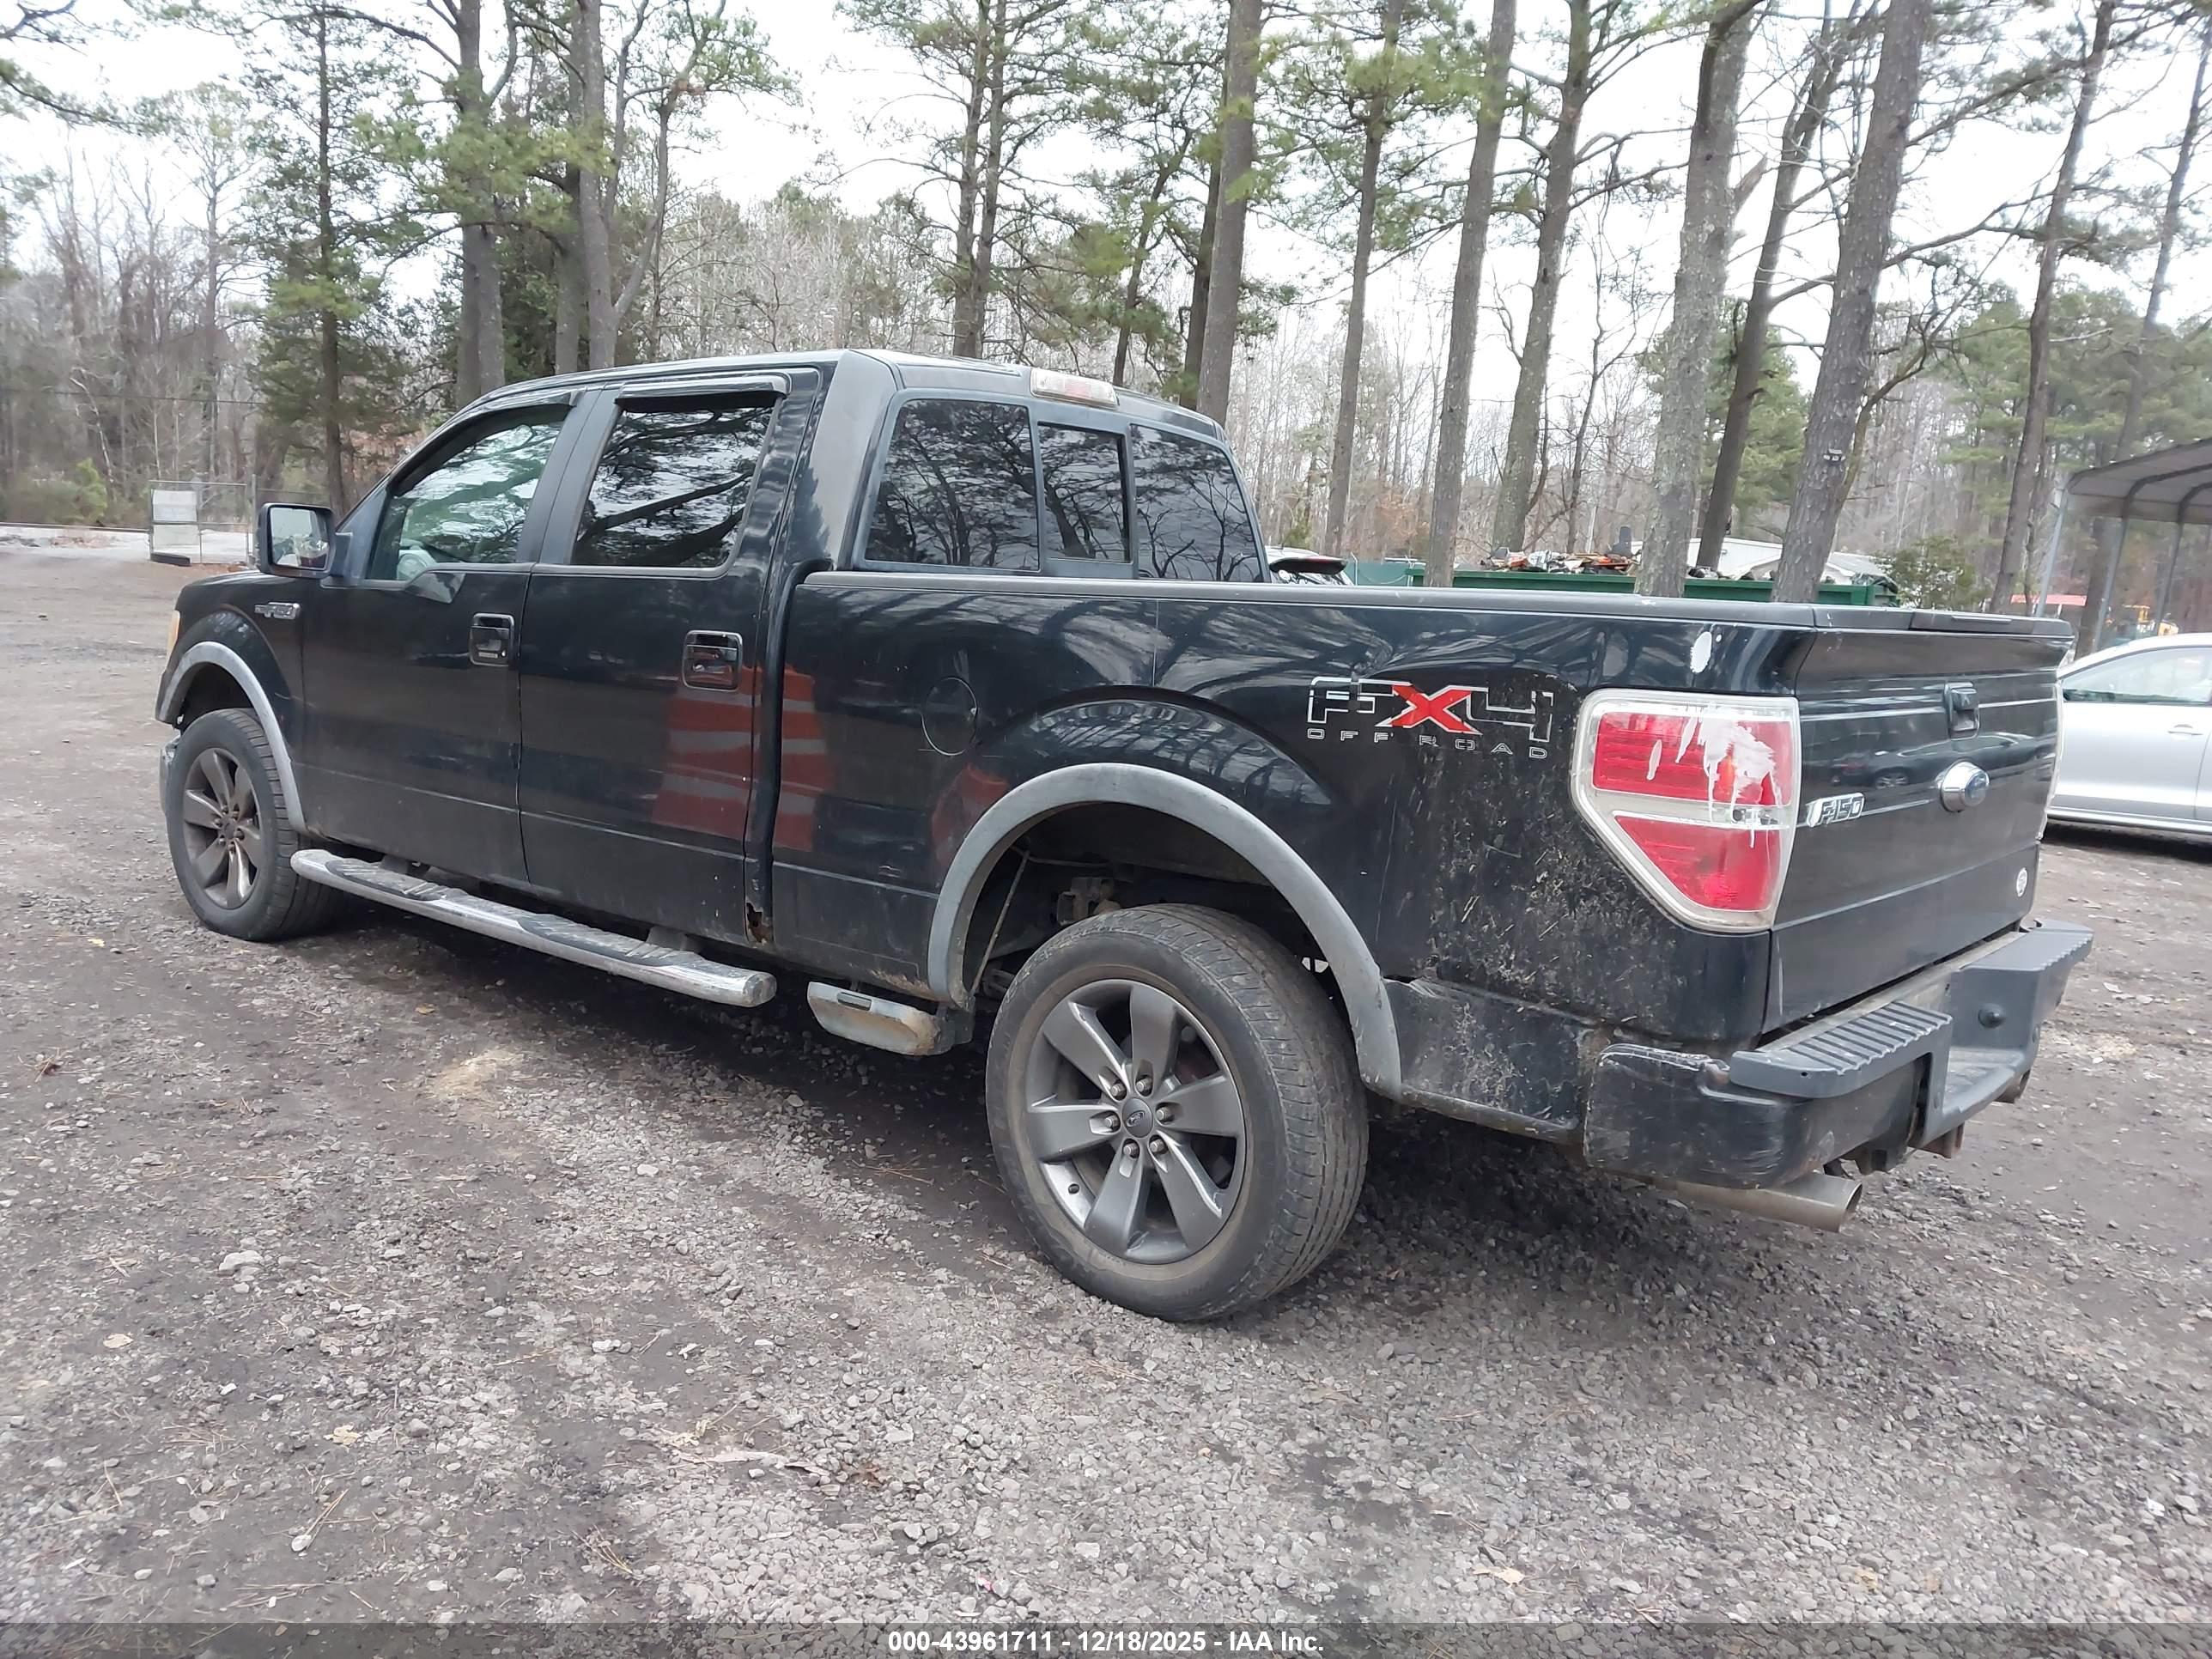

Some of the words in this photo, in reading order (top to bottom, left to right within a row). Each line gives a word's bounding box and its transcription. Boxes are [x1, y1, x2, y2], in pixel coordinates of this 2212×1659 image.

[1307, 677, 1554, 742] FX4
[1306, 727, 1395, 743] OFF
[1419, 734, 1548, 760] ROAD
